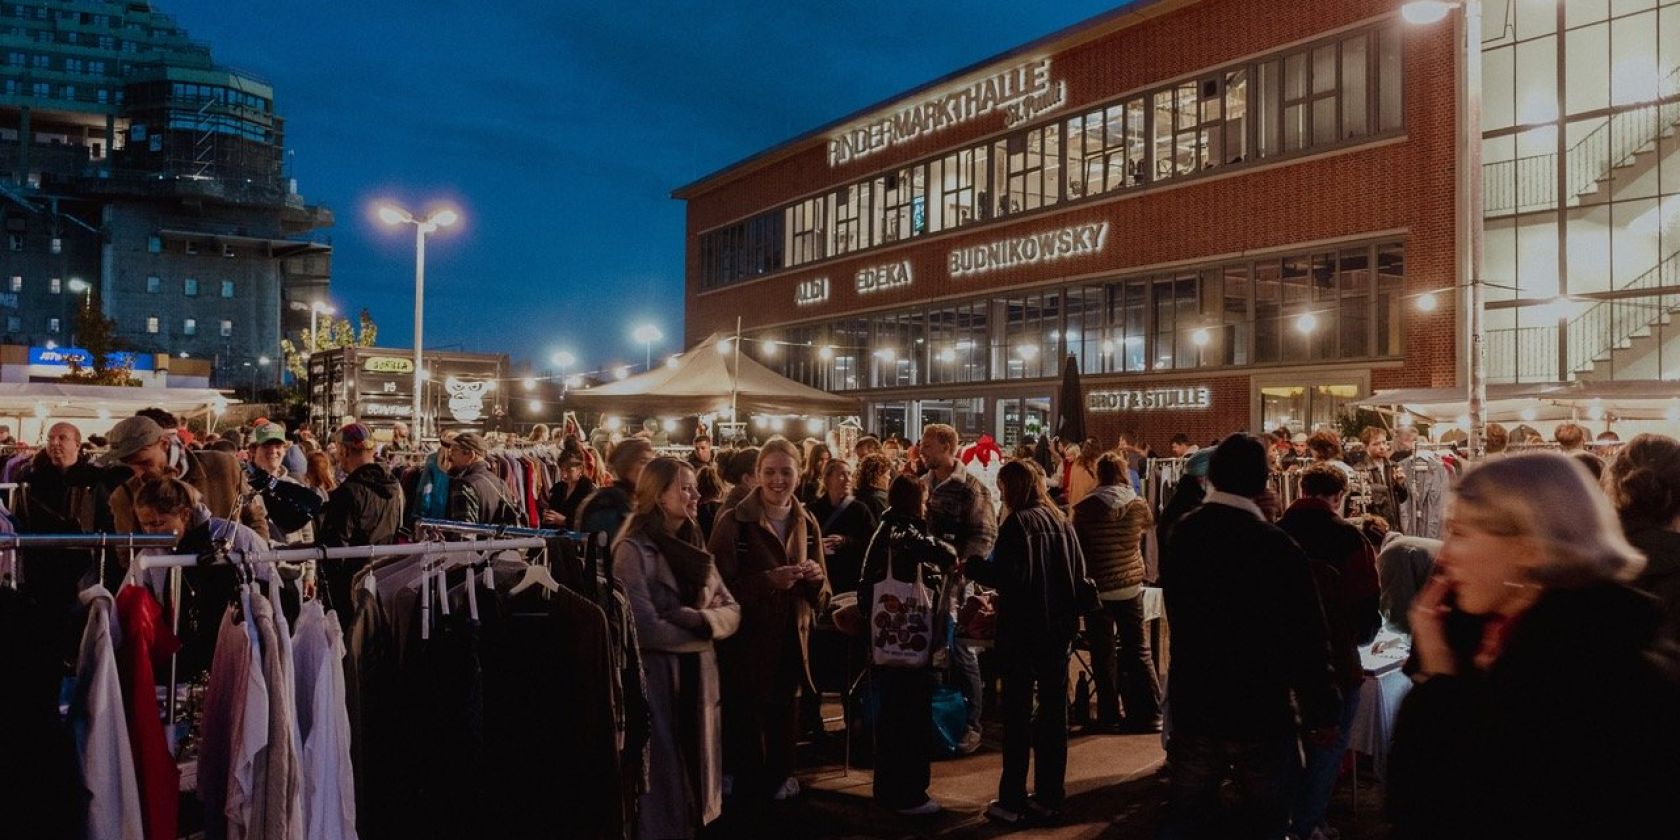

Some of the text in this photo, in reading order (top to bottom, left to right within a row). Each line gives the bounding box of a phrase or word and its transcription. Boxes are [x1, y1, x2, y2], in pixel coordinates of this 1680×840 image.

[828, 57, 1051, 167] RINDERMARKTHALLE
[795, 222, 1109, 305] ALDI EDEKA BUDNIKOWSKY
[1089, 392, 1127, 409] BROT
[1141, 388, 1207, 409] STULLE
